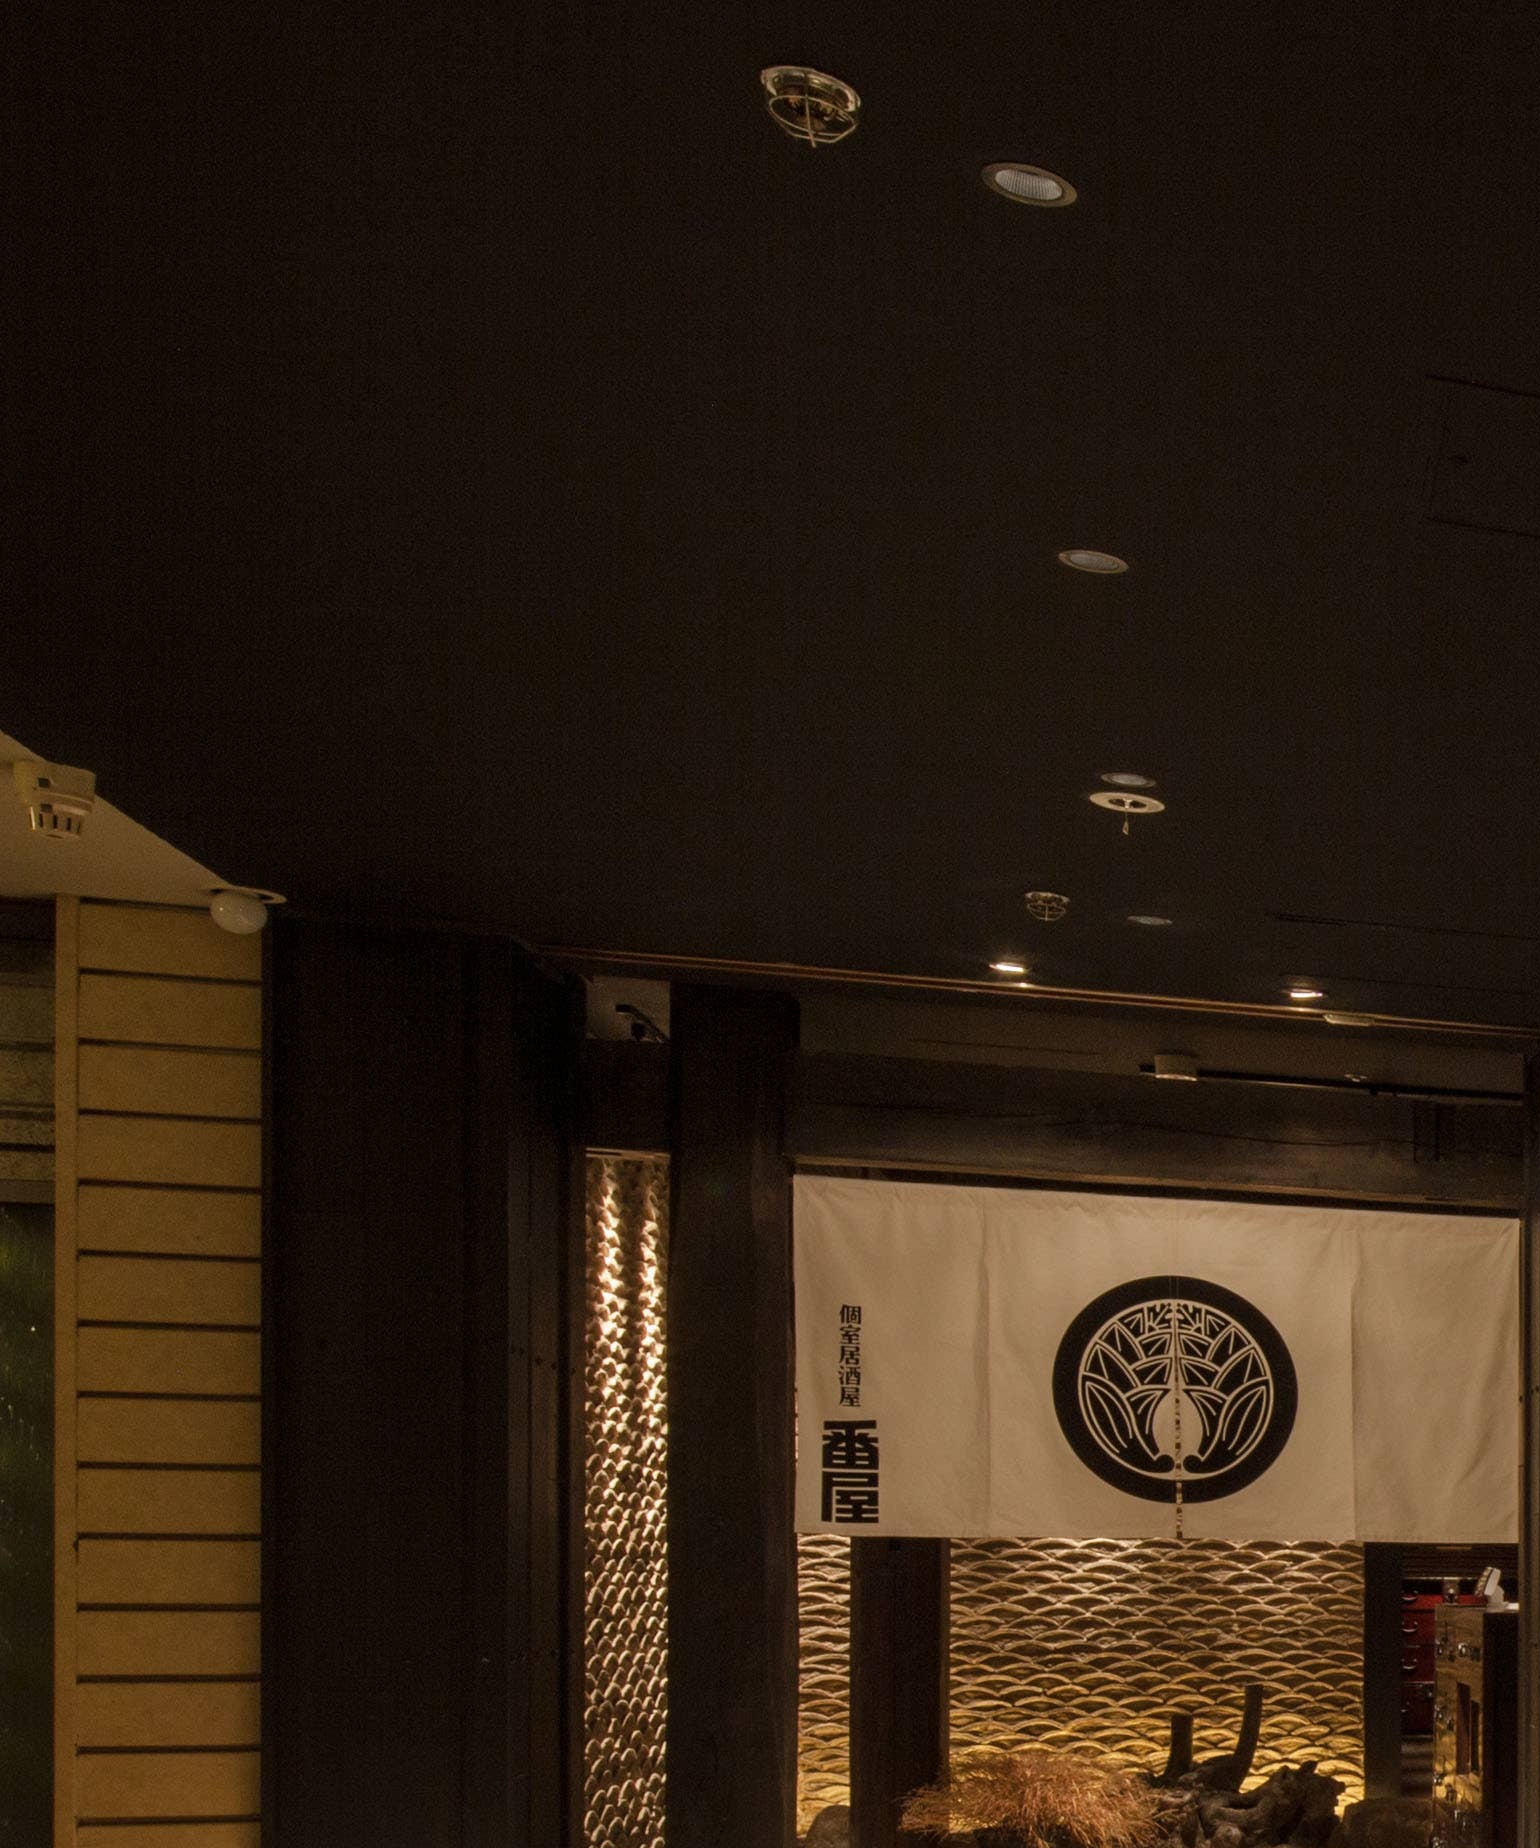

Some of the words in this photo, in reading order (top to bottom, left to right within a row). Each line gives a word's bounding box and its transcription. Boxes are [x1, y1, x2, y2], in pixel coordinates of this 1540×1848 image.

[837, 1303, 863, 1408] 個室居酒屋
[821, 1419, 880, 1524] 番屋
